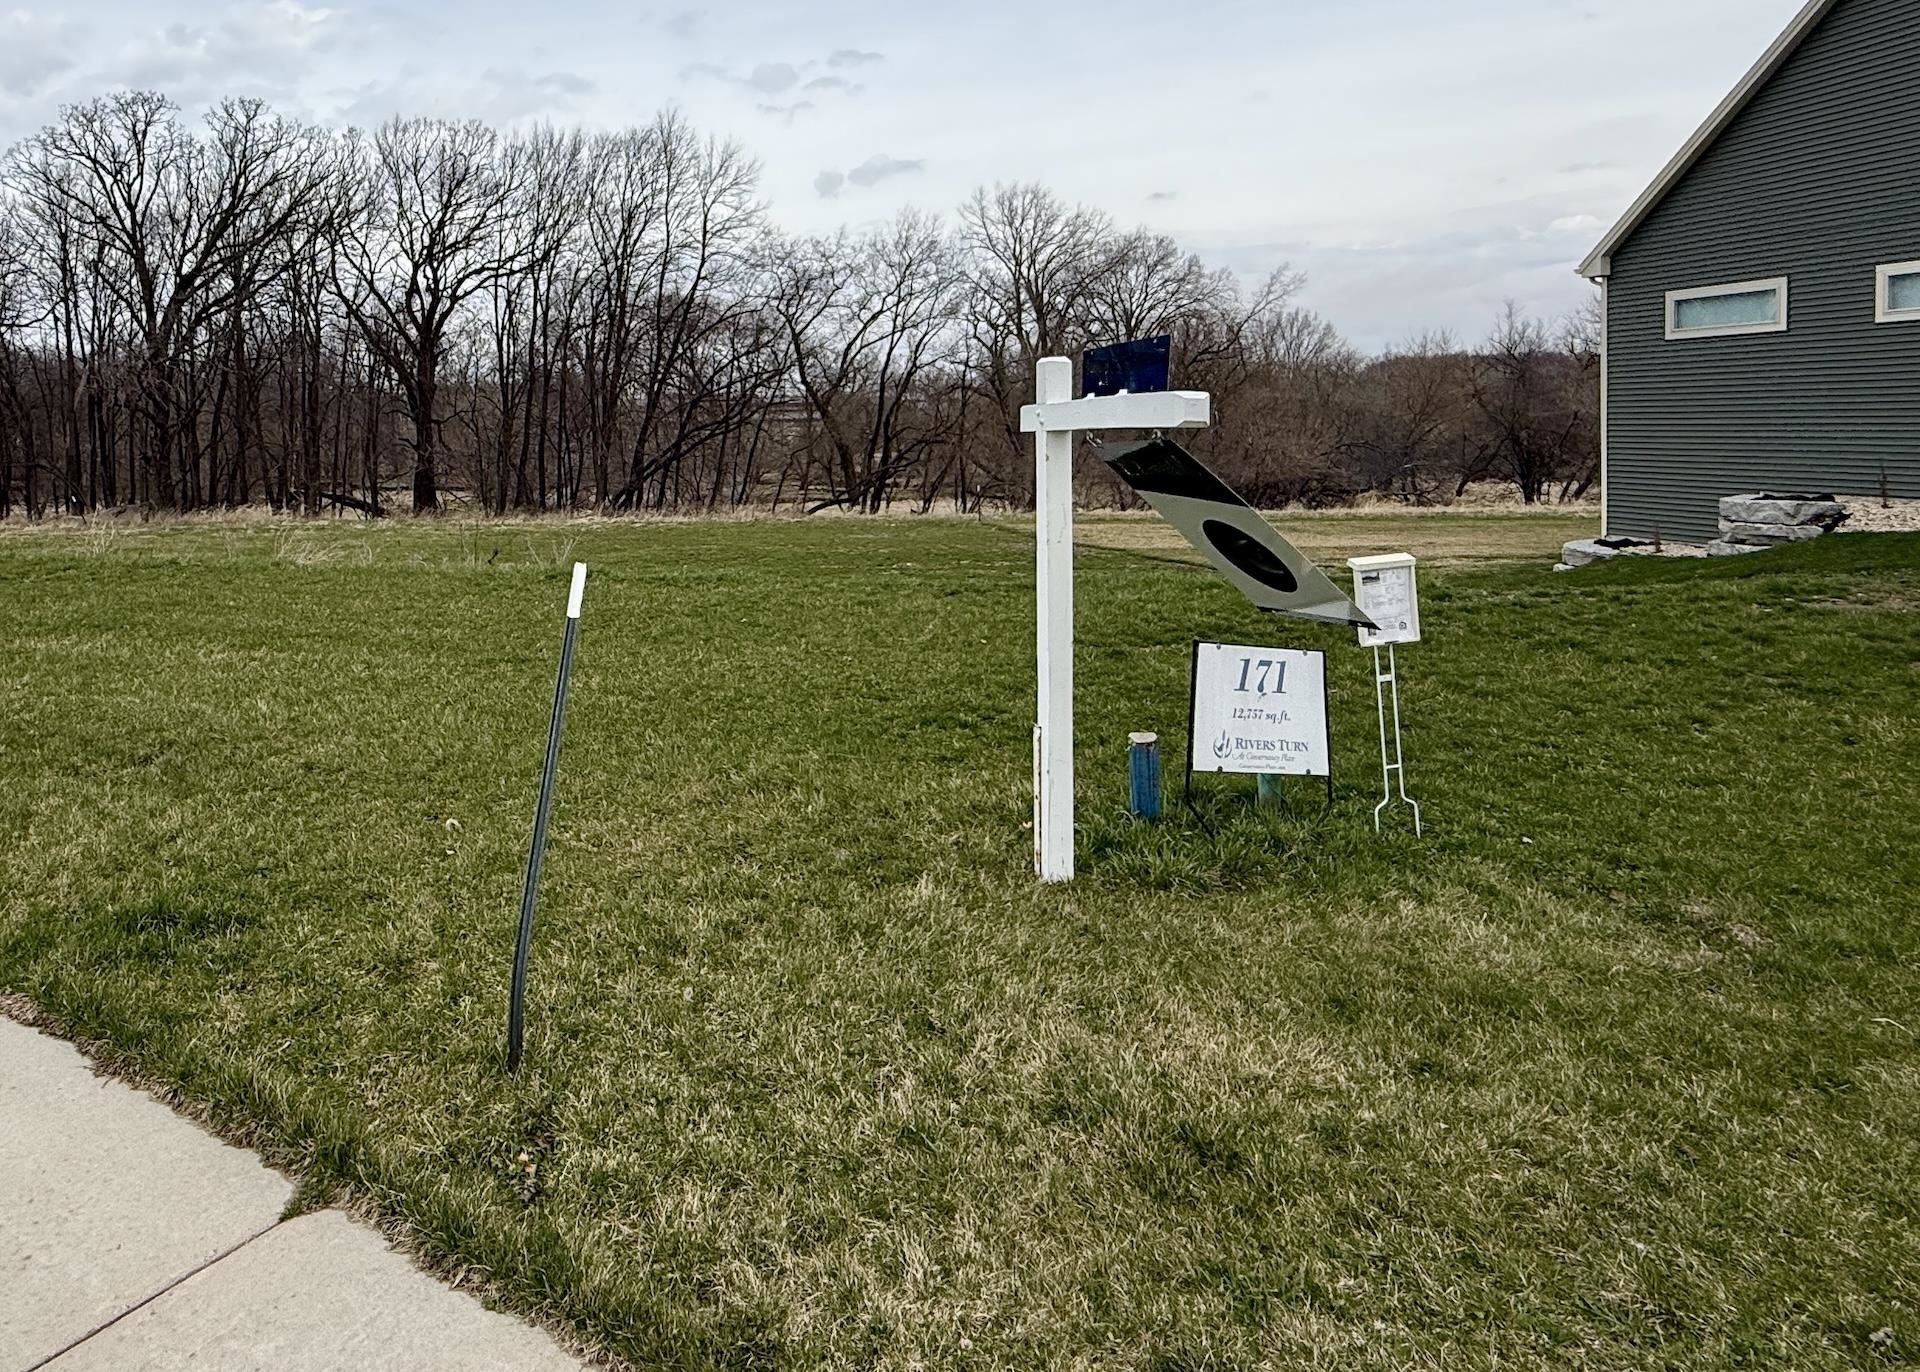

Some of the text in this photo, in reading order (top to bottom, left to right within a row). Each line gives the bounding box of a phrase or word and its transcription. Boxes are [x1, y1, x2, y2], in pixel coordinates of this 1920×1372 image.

[1233, 658, 1287, 694] 171
[1232, 708, 1264, 720] 12,757
[1235, 737, 1309, 752] RIVERS TURN
